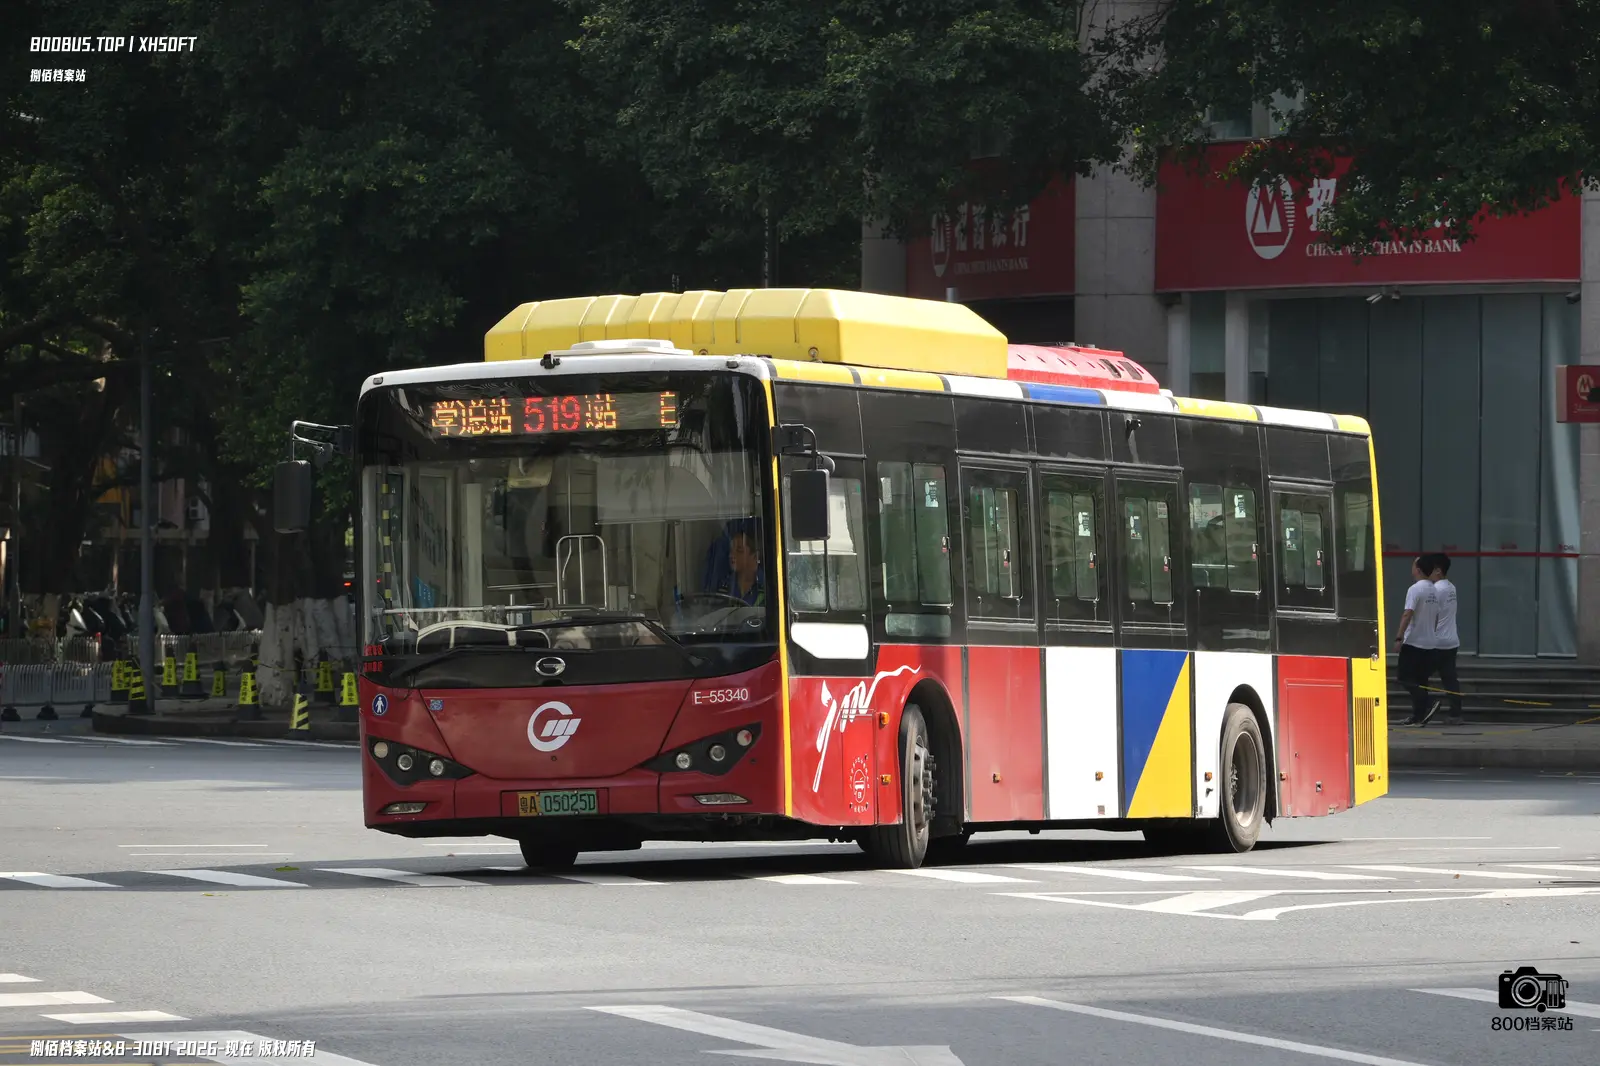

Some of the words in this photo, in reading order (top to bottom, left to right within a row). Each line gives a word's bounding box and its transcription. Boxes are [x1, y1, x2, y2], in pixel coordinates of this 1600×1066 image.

[1424, 239, 1462, 253] BANK
[524, 396, 580, 432] 519
[694, 688, 749, 705] E-55340
